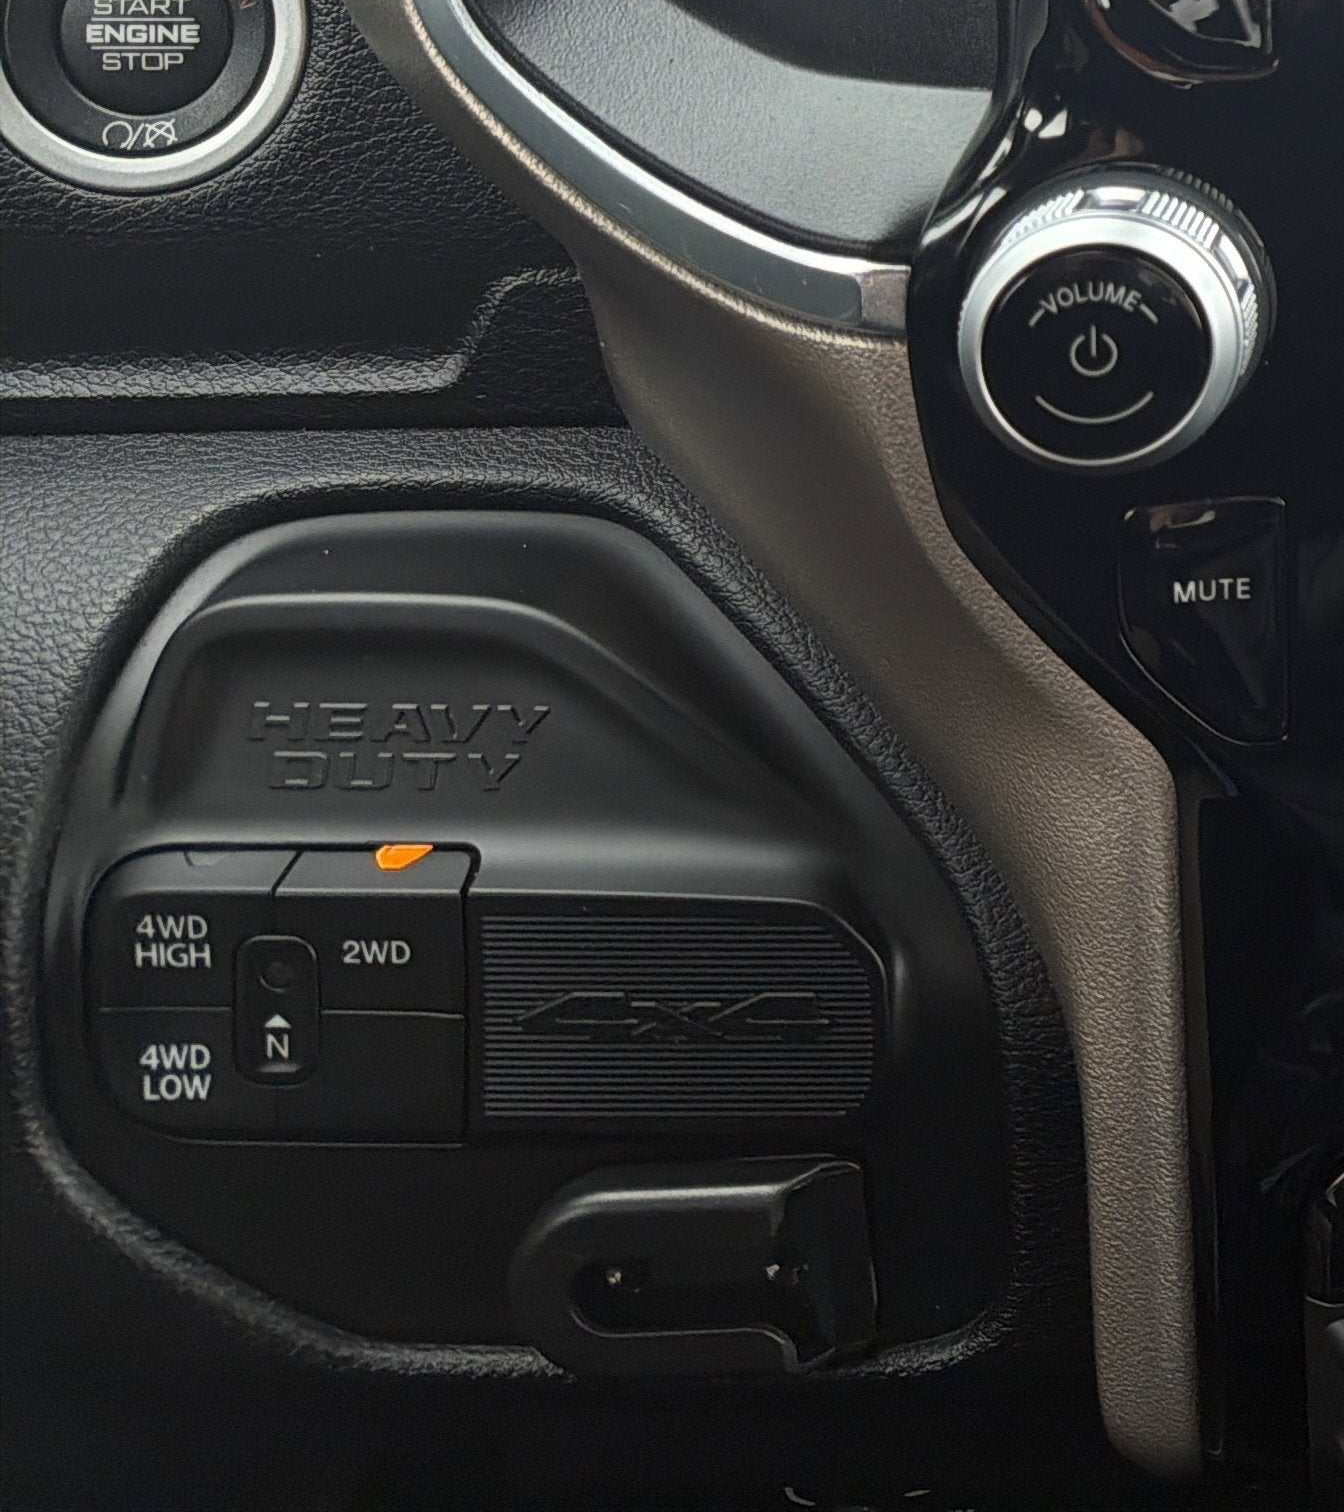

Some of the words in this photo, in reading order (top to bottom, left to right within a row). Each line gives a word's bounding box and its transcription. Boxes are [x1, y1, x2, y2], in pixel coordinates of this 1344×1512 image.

[85, 23, 200, 44] ENGINE
[102, 52, 184, 71] STOP
[1040, 281, 1140, 315] VOLUME
[1173, 577, 1251, 603] MUTE
[248, 700, 550, 743] HEAVY
[266, 750, 522, 792] DUTY
[136, 914, 208, 940] 4WD
[135, 942, 211, 968] HIGH
[342, 940, 411, 964] 2WD
[140, 1044, 211, 1070] 4WD
[266, 1033, 289, 1059] N
[143, 1074, 212, 1101] LOW
